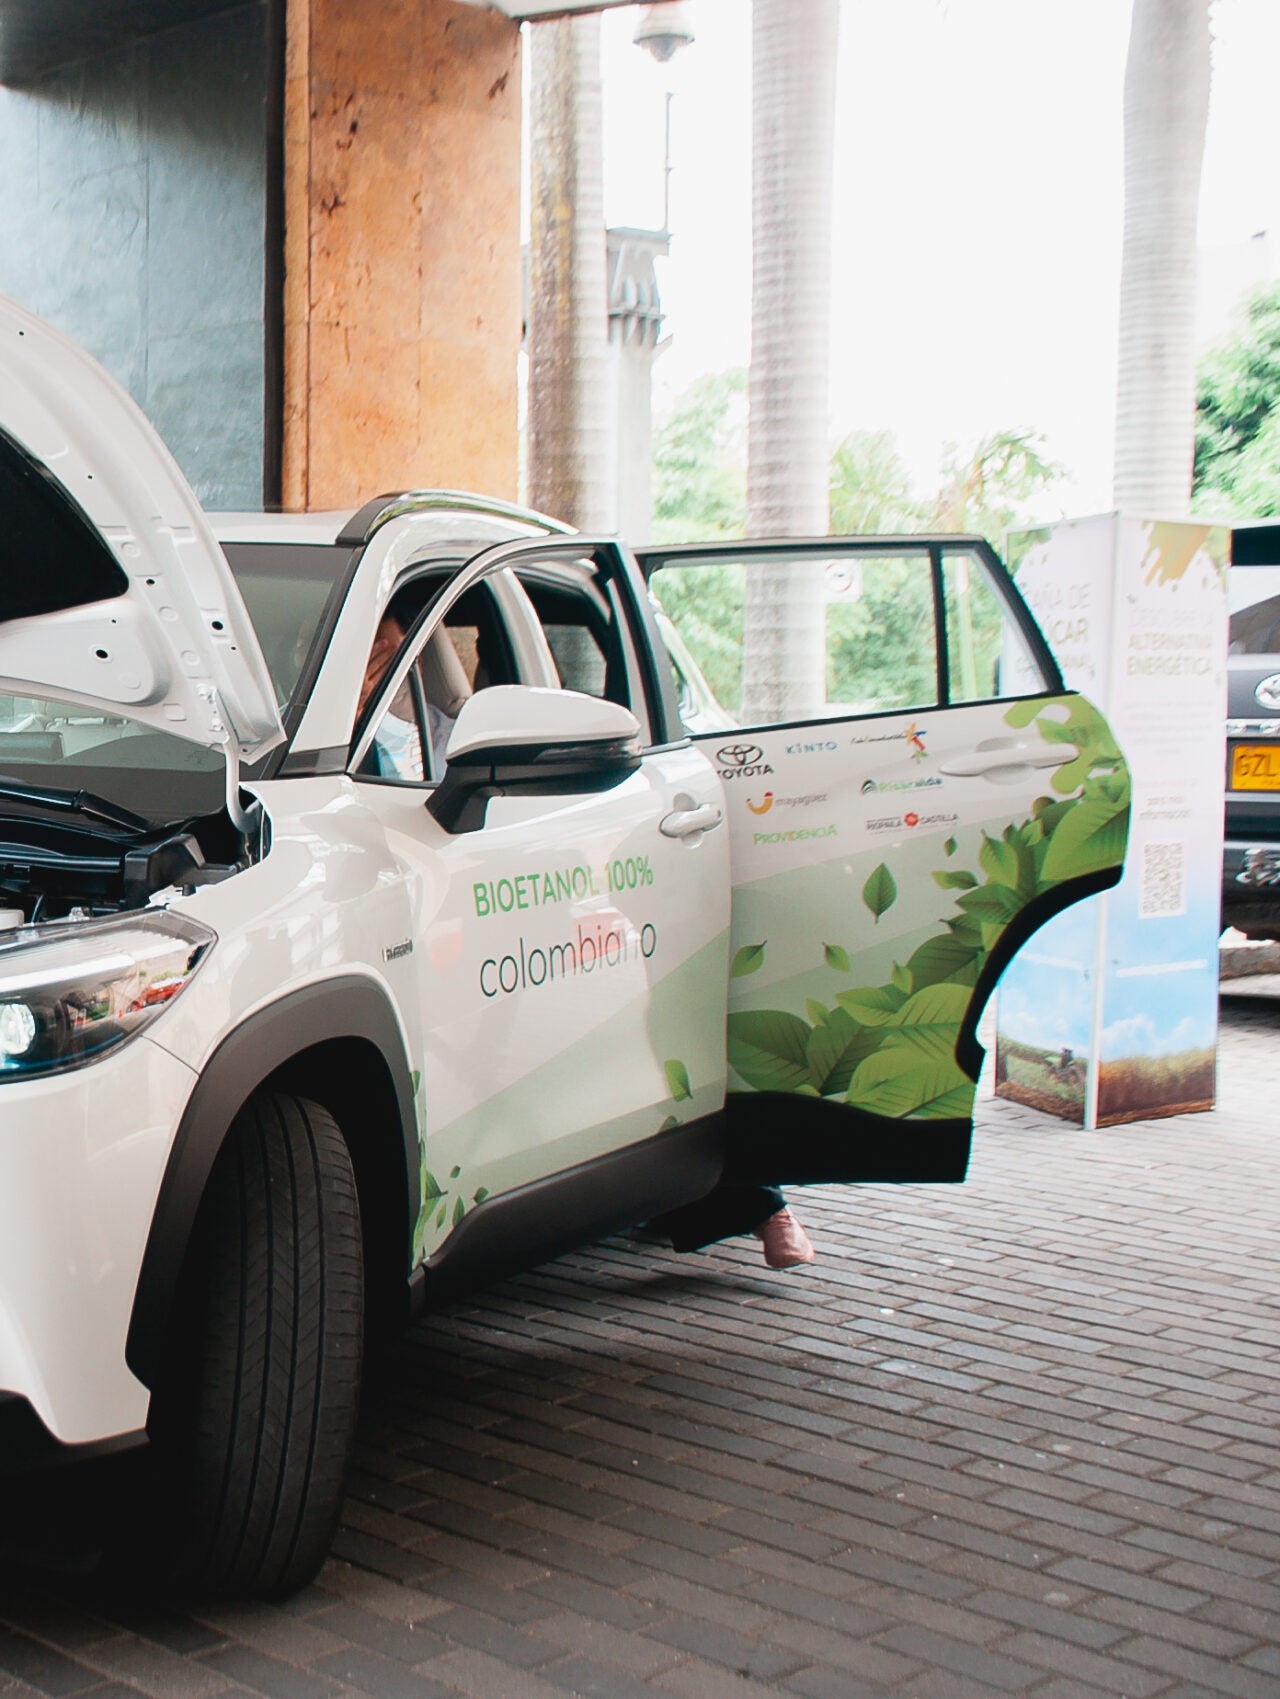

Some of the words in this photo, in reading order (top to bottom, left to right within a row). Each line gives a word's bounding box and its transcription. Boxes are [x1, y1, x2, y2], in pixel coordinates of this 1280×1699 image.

[786, 741, 838, 754] KINTO
[717, 764, 775, 779] OYOTA
[753, 824, 839, 845] PROVIDENCIA
[473, 865, 600, 917] BIOETANOL
[605, 855, 654, 894] 100%
[480, 923, 657, 998] colombiano
